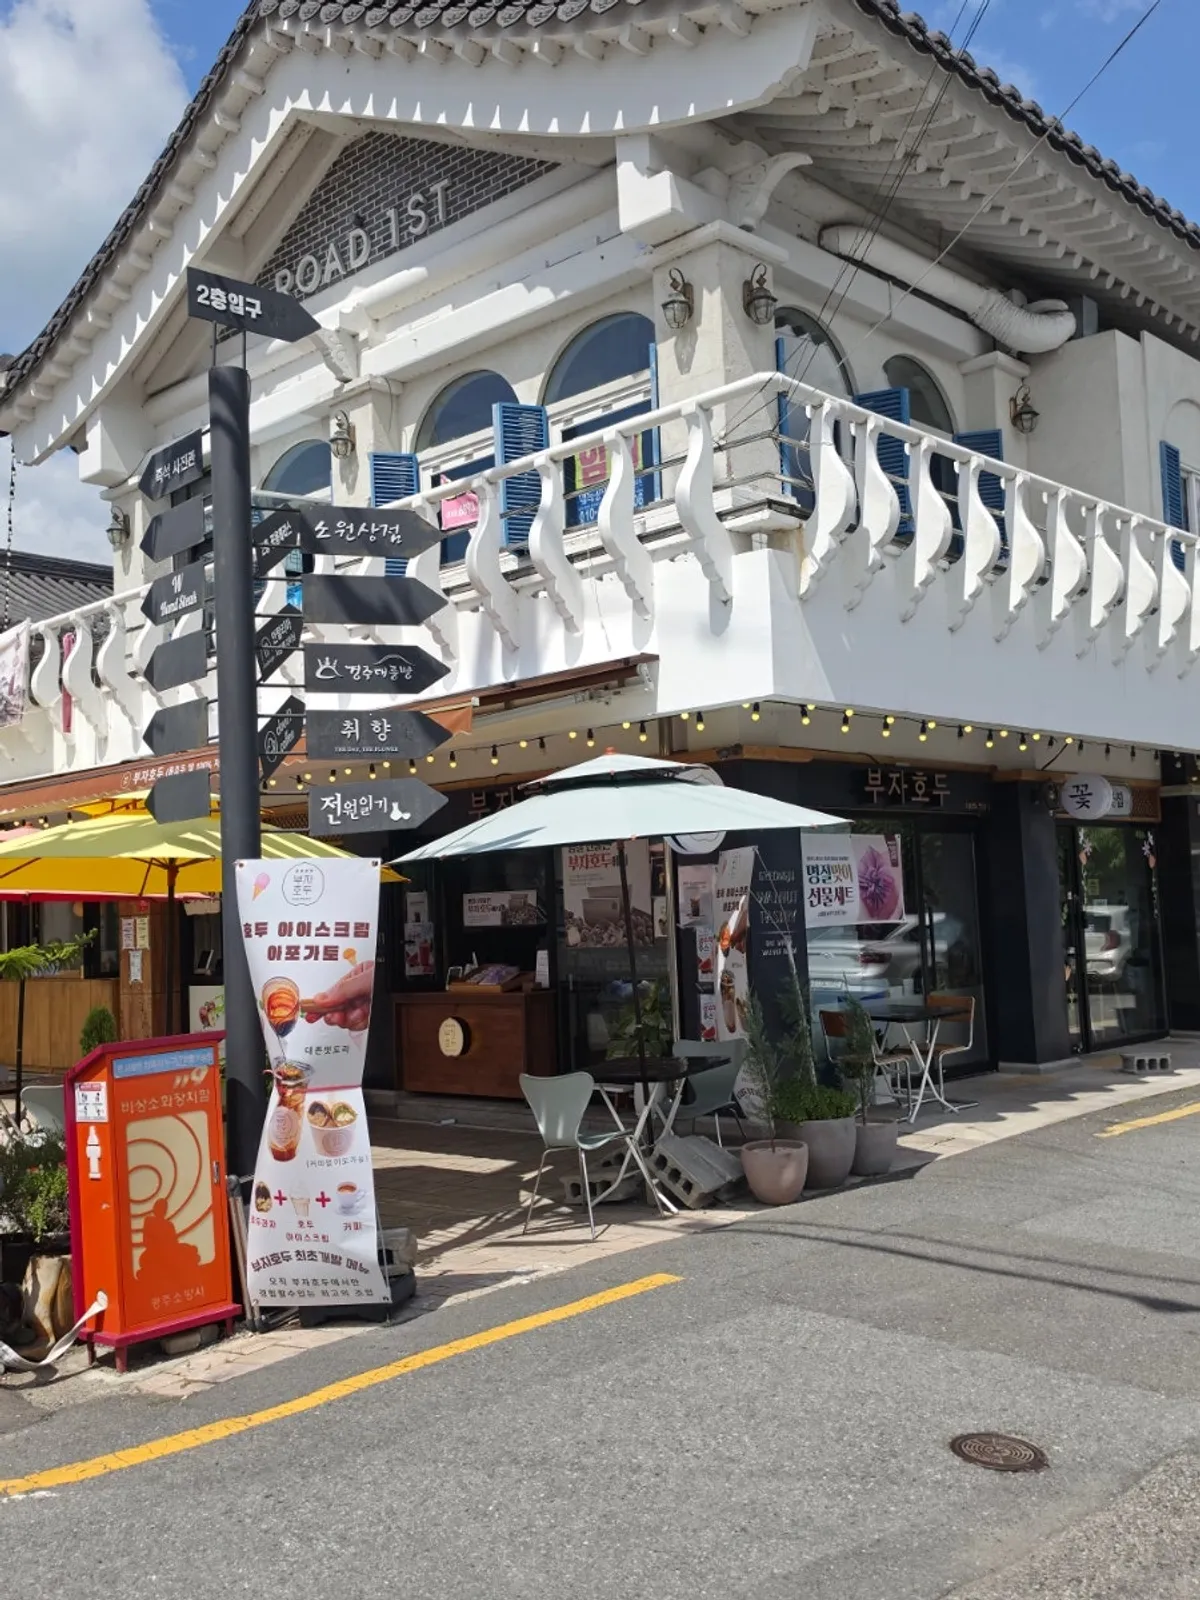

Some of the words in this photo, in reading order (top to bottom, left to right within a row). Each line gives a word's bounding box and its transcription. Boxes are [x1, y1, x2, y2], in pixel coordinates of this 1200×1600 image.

[275, 227, 371, 295] ROAD
[196, 283, 263, 319] 2층입구
[154, 462, 171, 484] 즉석
[171, 448, 196, 475] 사진관
[315, 520, 404, 544] 소원상점
[132, 766, 164, 784] 부자호두
[864, 768, 951, 806] 부자호두
[1068, 784, 1093, 809] 꽃
[321, 793, 388, 826] 전원일기
[806, 863, 853, 884] 명절맞이
[807, 886, 854, 908] 선물세트
[243, 922, 268, 938] 호두
[278, 921, 370, 938] 아이스크림
[267, 945, 340, 962] 아포가토
[121, 1089, 210, 1114] 비상소화장치함
[286, 1233, 330, 1242] 아이스크림
[297, 1220, 315, 1228] 호두
[343, 1221, 362, 1231] 커피
[251, 1250, 292, 1272] 부자호두
[346, 1257, 370, 1274] 메뉴
[269, 1277, 287, 1287] 오직
[292, 1277, 359, 1287] 부자호두에서만
